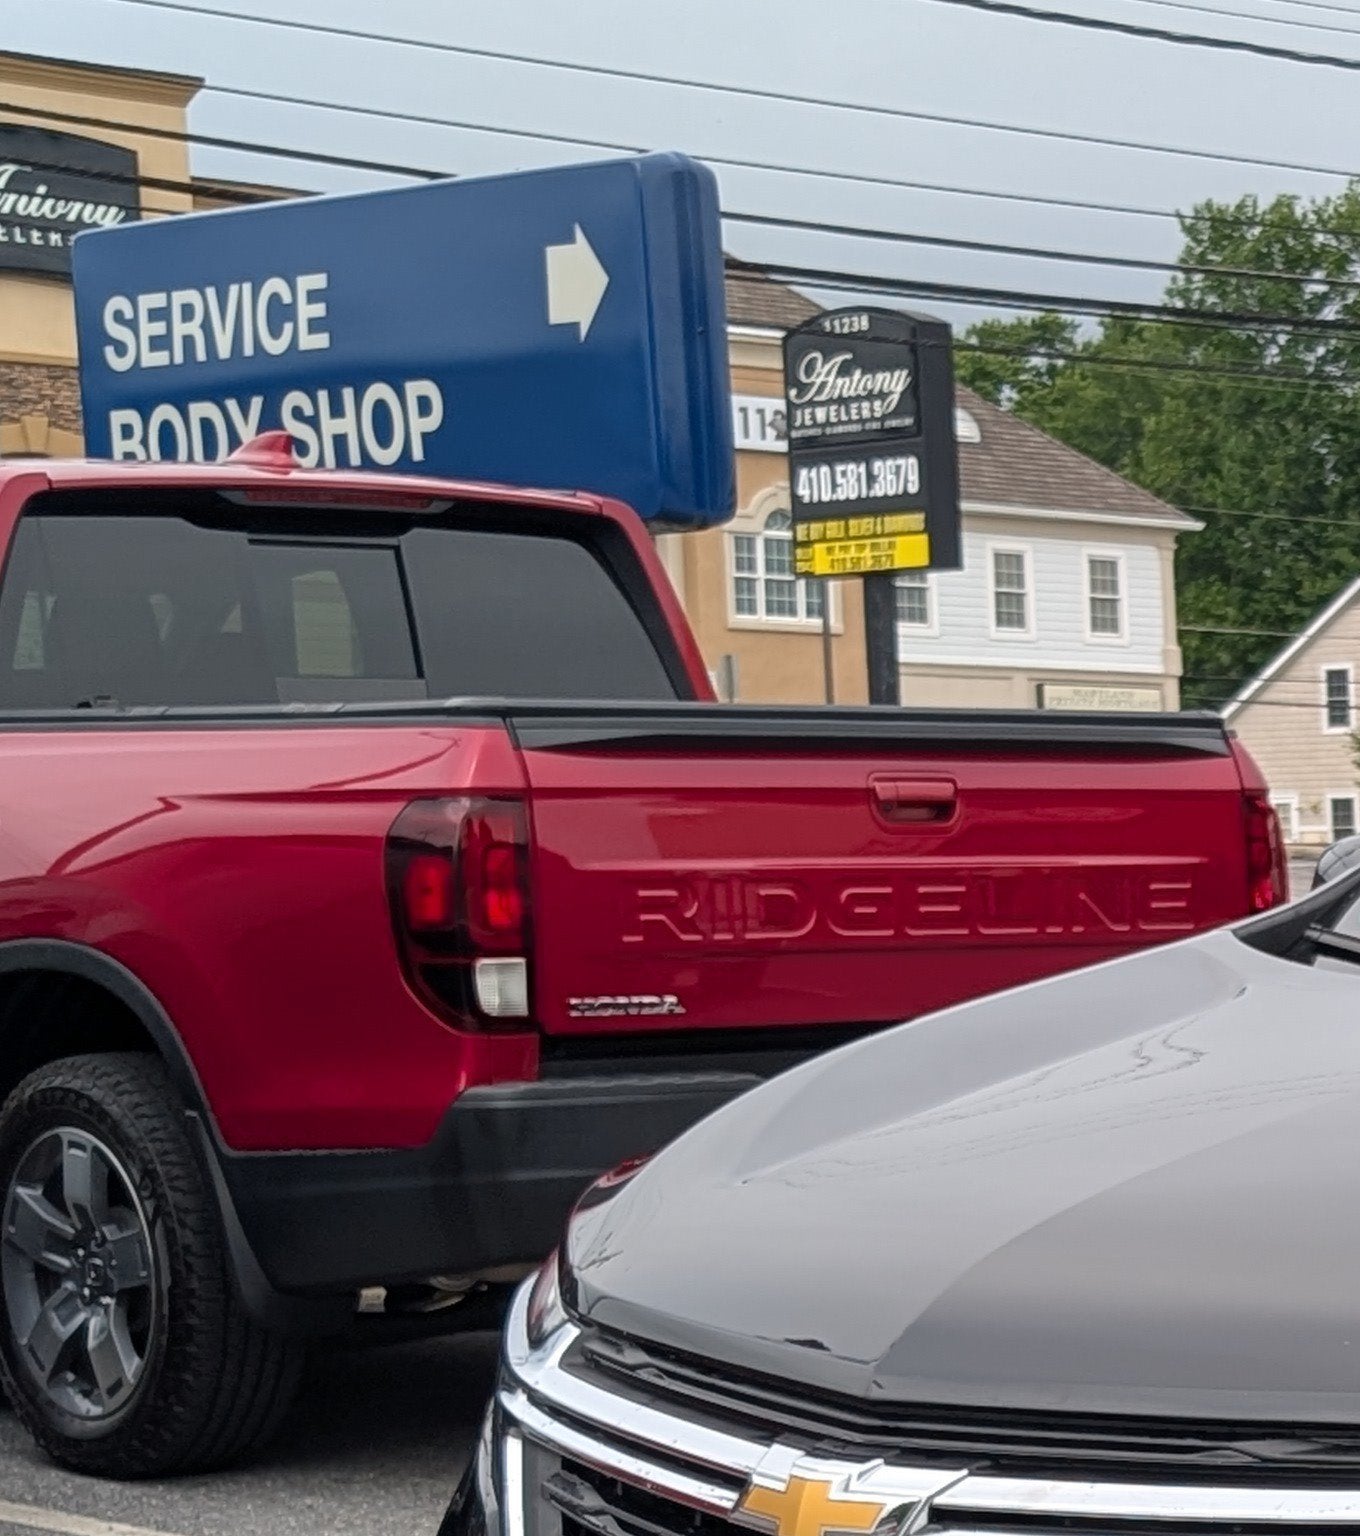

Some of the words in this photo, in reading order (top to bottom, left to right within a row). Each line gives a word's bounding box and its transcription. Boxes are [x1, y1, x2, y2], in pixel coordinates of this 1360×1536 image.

[103, 272, 331, 374] SERVICE
[788, 350, 913, 415] Antony
[109, 396, 263, 465] BODY
[281, 379, 445, 470] SHOP
[794, 400, 883, 428] JEWELERS
[796, 455, 920, 504] 410.581.3679
[622, 880, 1196, 942] RIDGELINE
[568, 995, 687, 1017] HONDA
